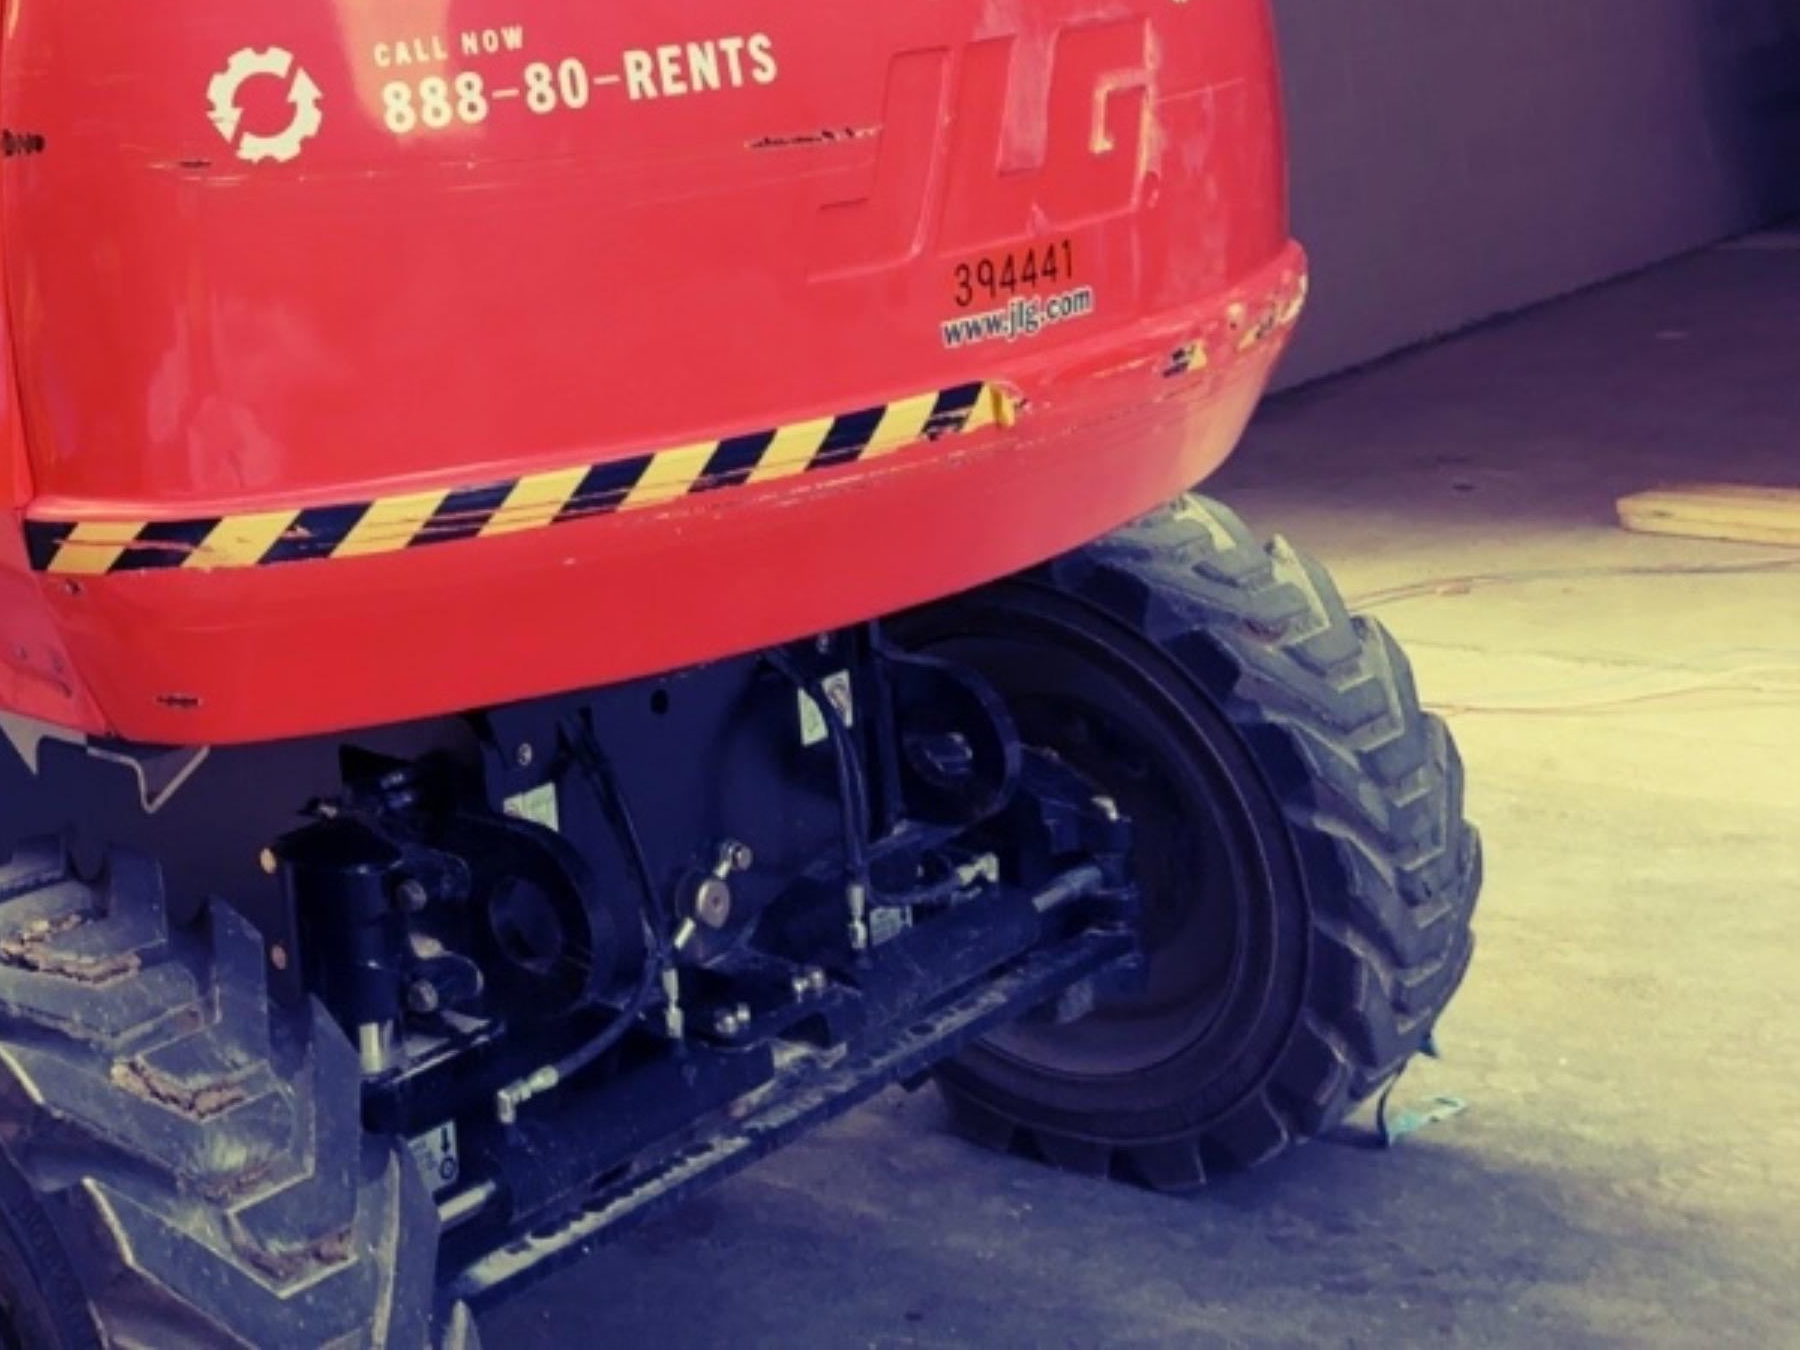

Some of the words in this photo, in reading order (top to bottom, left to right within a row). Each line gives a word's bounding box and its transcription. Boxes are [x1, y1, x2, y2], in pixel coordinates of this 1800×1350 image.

[373, 35, 450, 68] CALL
[460, 25, 524, 56] NOW
[381, 33, 778, 134] 888-80-RENTS
[953, 240, 1074, 307] 394441
[943, 287, 1092, 347] www.jlg.com
